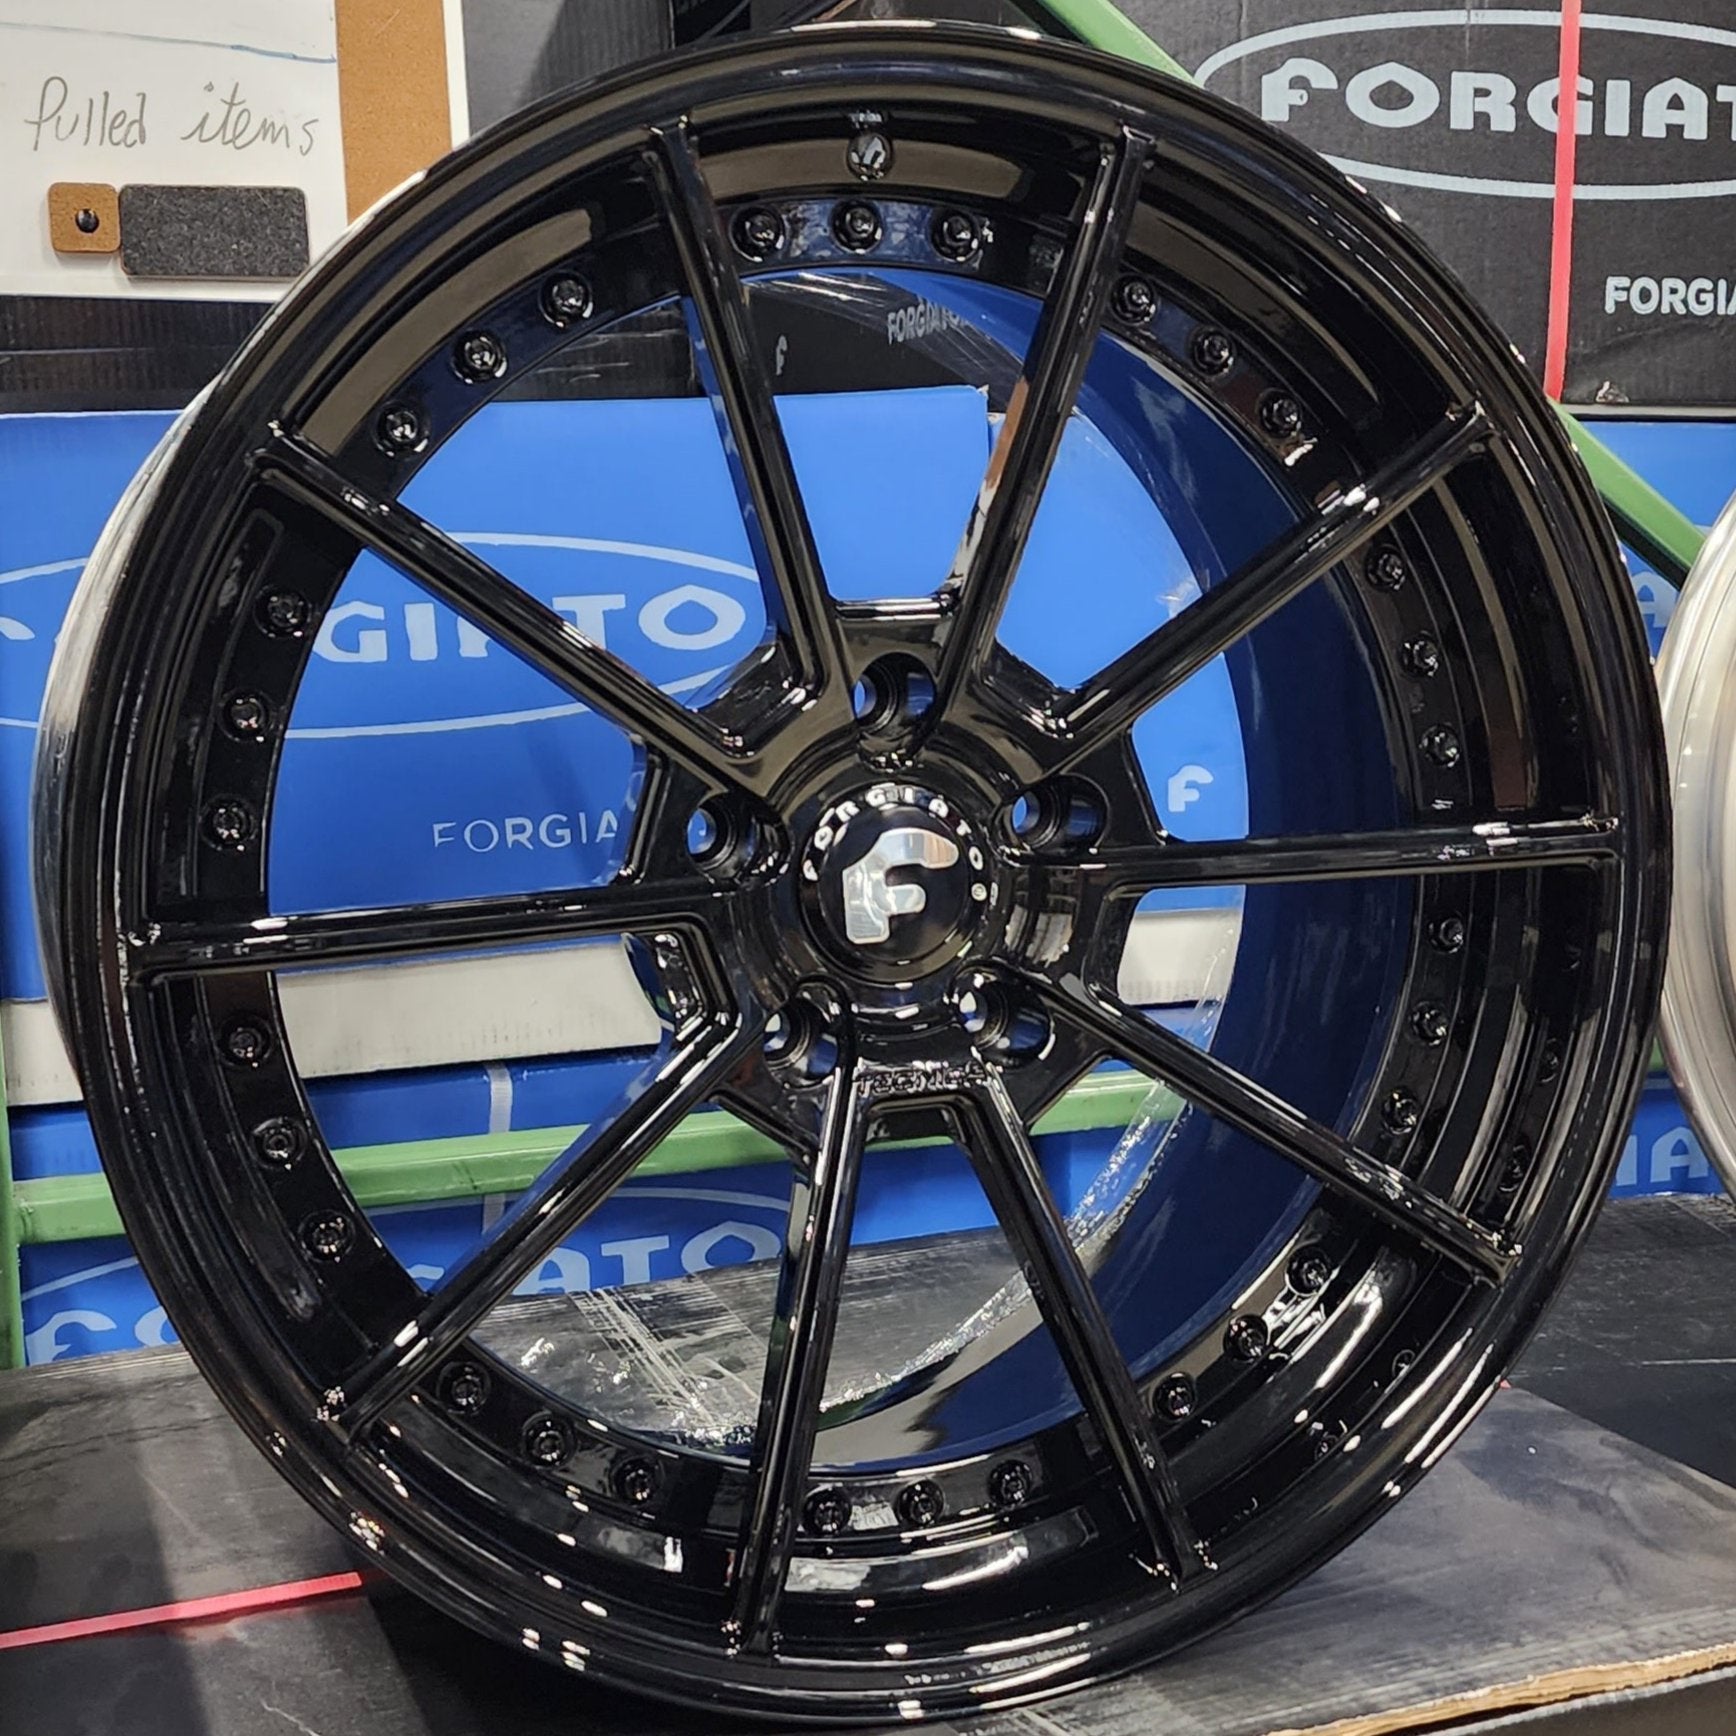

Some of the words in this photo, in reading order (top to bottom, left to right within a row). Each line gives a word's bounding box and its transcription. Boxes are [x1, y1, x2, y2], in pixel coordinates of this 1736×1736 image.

[181, 81, 319, 156] items
[1167, 764, 1214, 813] F
[842, 826, 960, 945] F
